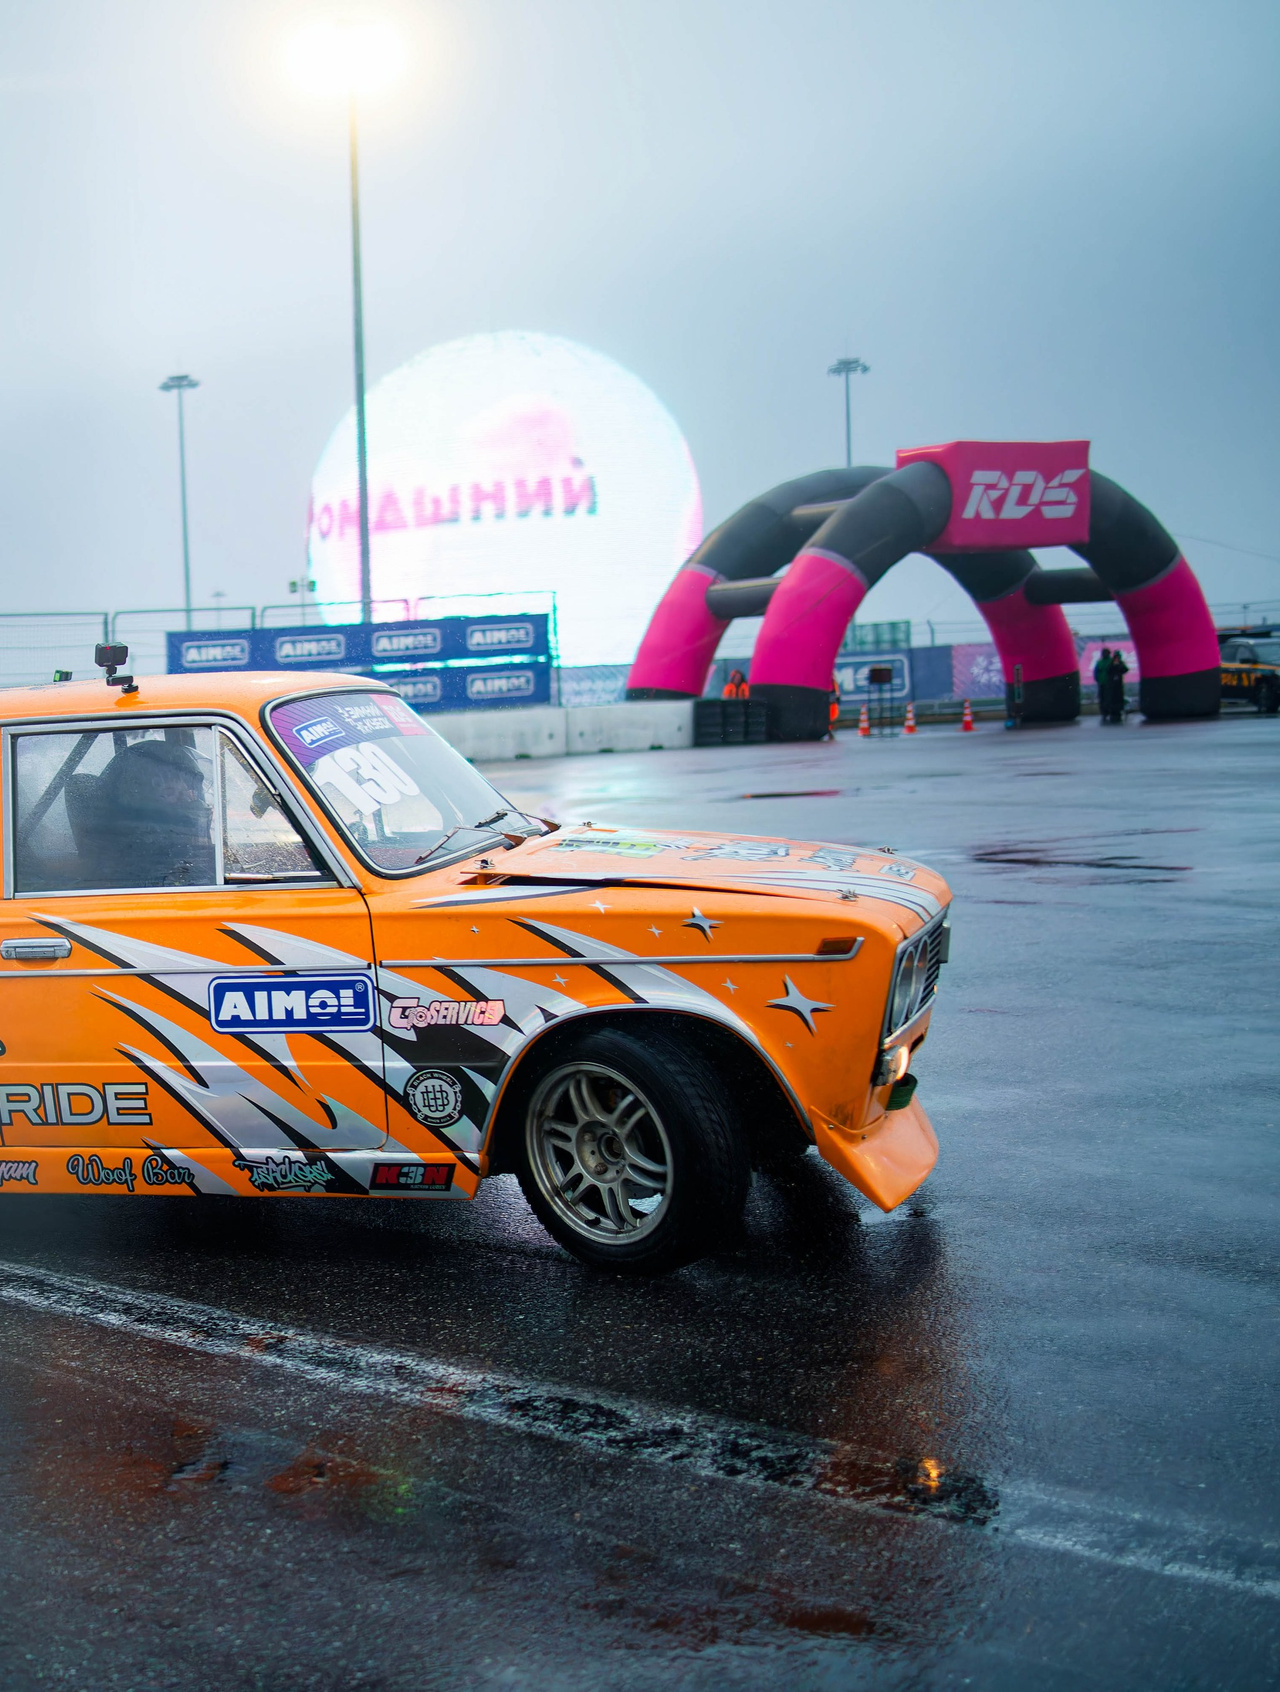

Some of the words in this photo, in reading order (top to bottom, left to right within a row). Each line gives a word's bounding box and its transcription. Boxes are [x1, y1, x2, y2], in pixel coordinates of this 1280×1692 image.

[308, 457, 598, 540] ОМАШНИЙ
[961, 468, 1087, 519] RDS
[376, 634, 436, 650] AIMOL
[471, 628, 529, 645] AIMOL
[186, 645, 243, 662] AIMOL
[280, 640, 338, 658] AIMOL
[471, 676, 528, 694] AIMOL
[299, 720, 341, 744] AIMOL
[310, 741, 420, 816] 130
[217, 989, 366, 1021] AIMOL
[67, 1154, 137, 1192] Woof
[142, 1156, 196, 1184] Bar
[375, 1166, 449, 1185] K3N
